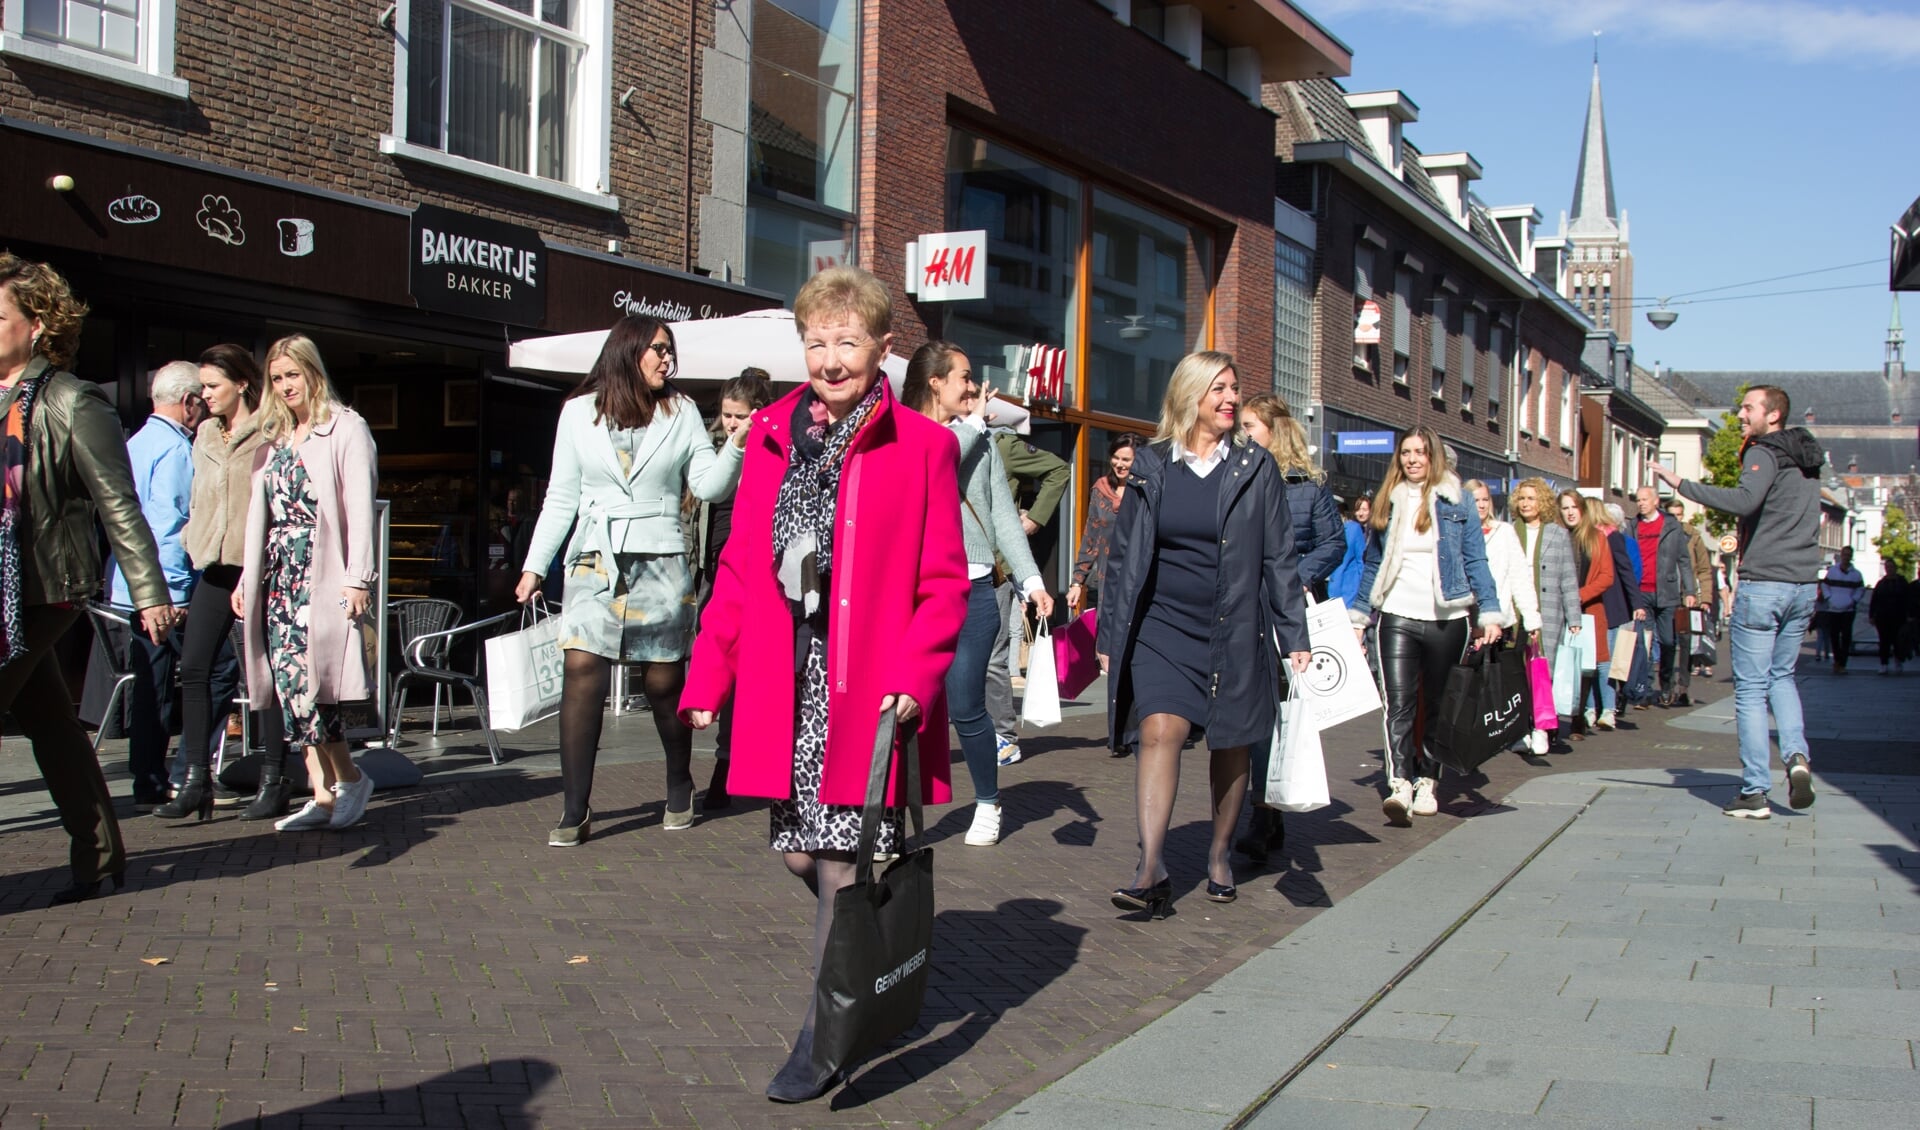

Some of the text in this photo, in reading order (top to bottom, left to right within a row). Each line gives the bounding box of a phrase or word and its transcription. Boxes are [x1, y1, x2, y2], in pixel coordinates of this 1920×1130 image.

[422, 227, 537, 288] BAKKERTJE
[924, 245, 977, 288] H&M
[447, 272, 512, 300] BAKKER
[613, 290, 692, 321] Ambachtelijk
[1026, 343, 1067, 405] H&M
[875, 948, 927, 995] GERRY WEBER
